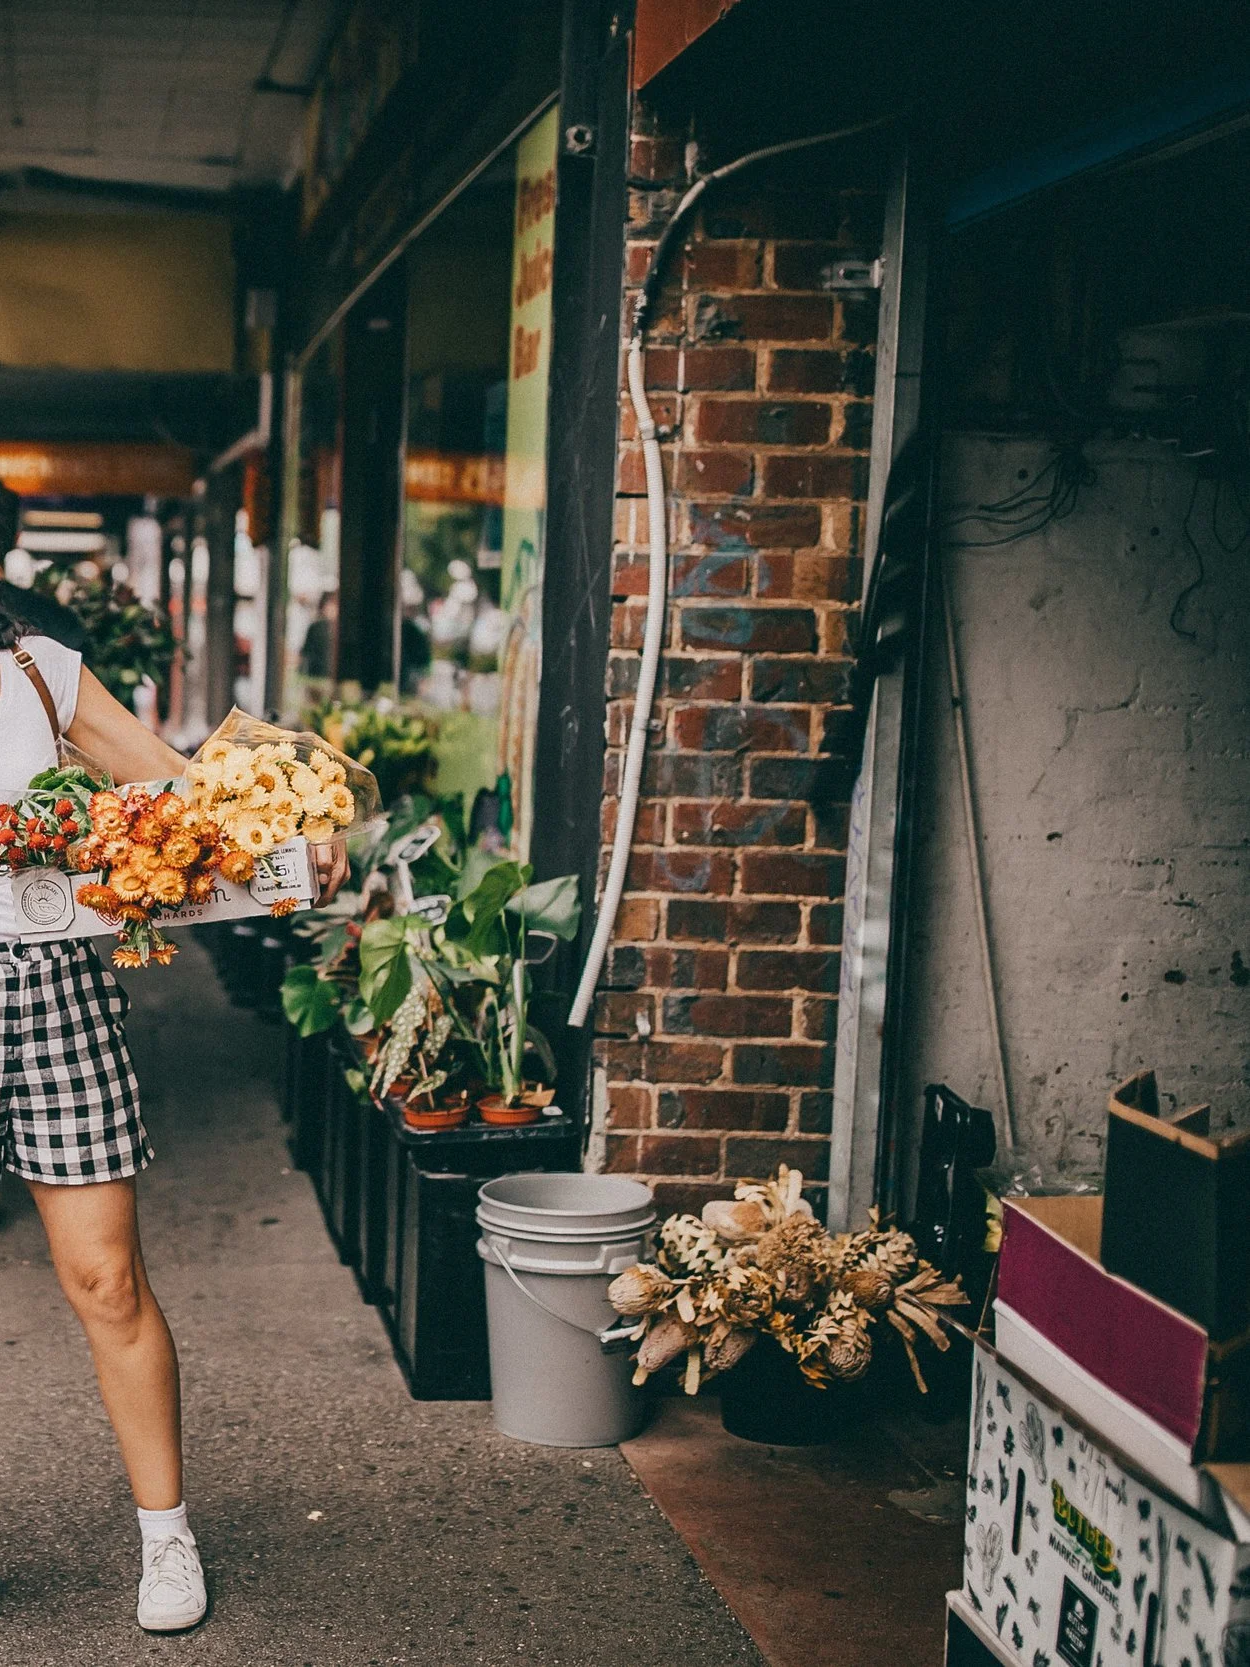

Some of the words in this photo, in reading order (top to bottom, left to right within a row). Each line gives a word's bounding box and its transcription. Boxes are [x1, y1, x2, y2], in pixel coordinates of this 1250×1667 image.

[156, 908, 204, 921] HARDS
[1048, 1532, 1081, 1573] MARKET
[1081, 1562, 1119, 1612] GARDENS
